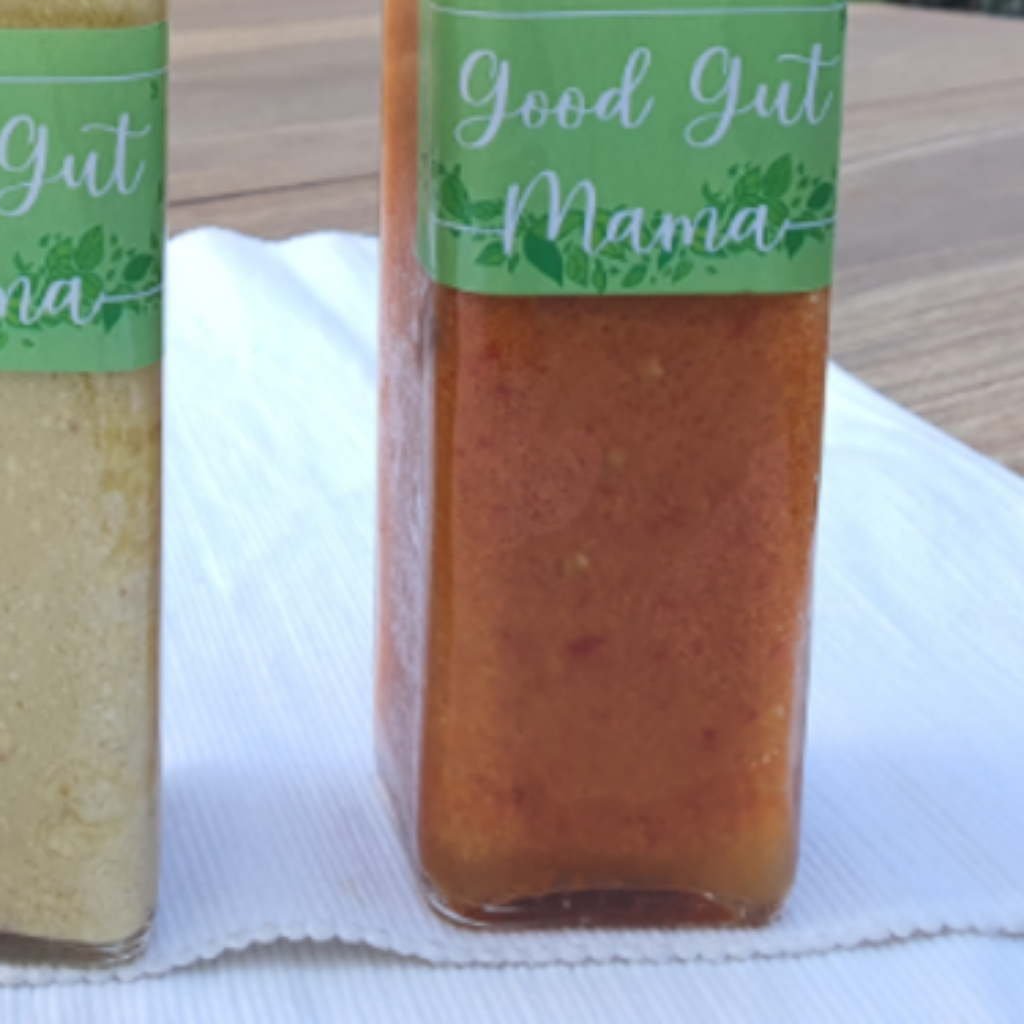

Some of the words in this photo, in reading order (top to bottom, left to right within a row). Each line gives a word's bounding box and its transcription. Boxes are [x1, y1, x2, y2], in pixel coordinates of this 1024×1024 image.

[454, 46, 655, 150] Good
[684, 42, 841, 149] Gut
[503, 169, 790, 256] Mama
